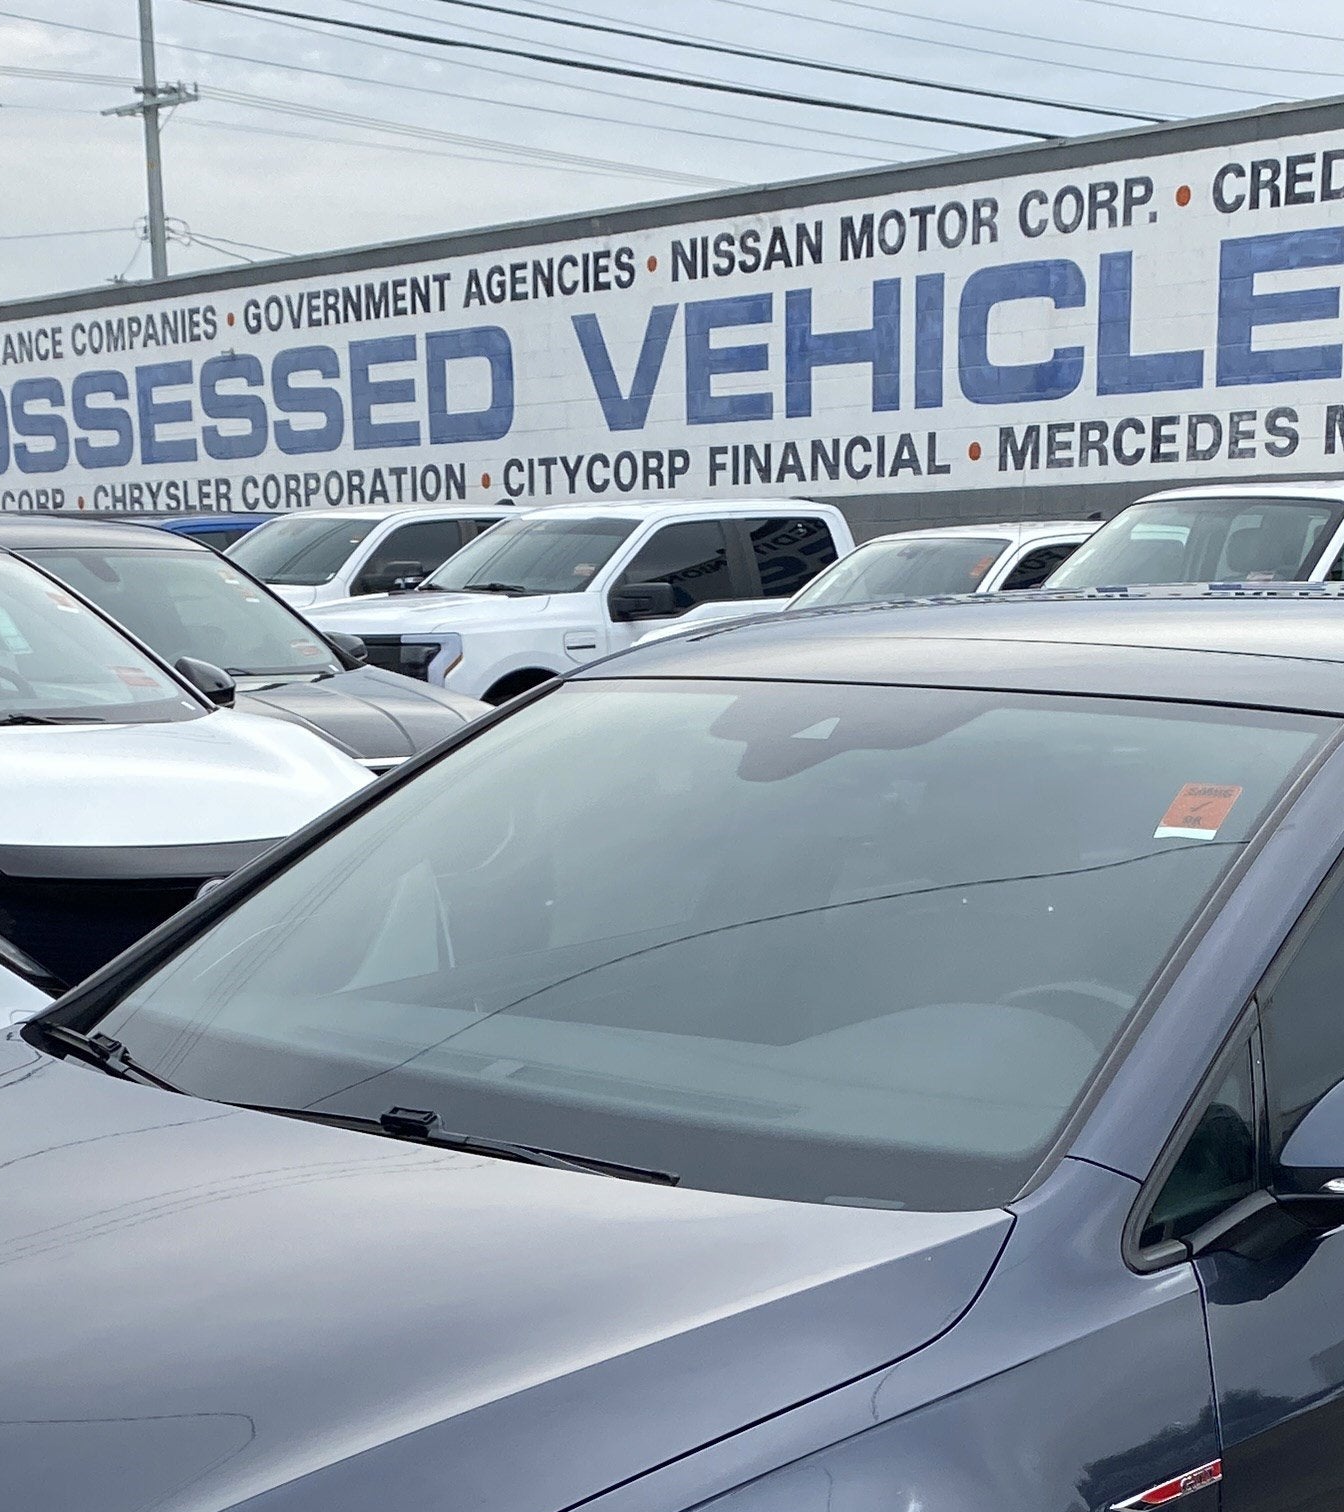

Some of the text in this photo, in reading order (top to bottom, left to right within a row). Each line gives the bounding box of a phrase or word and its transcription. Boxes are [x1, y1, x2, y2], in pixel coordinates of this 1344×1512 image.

[71, 305, 218, 356] COMPANIES
[243, 272, 451, 334] GOVERNMENT
[463, 246, 637, 308] AGENCIES
[670, 220, 824, 282] NISSAN
[839, 197, 999, 262] MOTOR
[1018, 176, 1158, 238] CORP.
[94, 478, 233, 513] CHRYSLER
[241, 462, 467, 511] CORPORATION
[502, 448, 691, 498] CITYCORP
[708, 431, 952, 487] FINANCIAL
[998, 405, 1300, 472] MERCEDES
